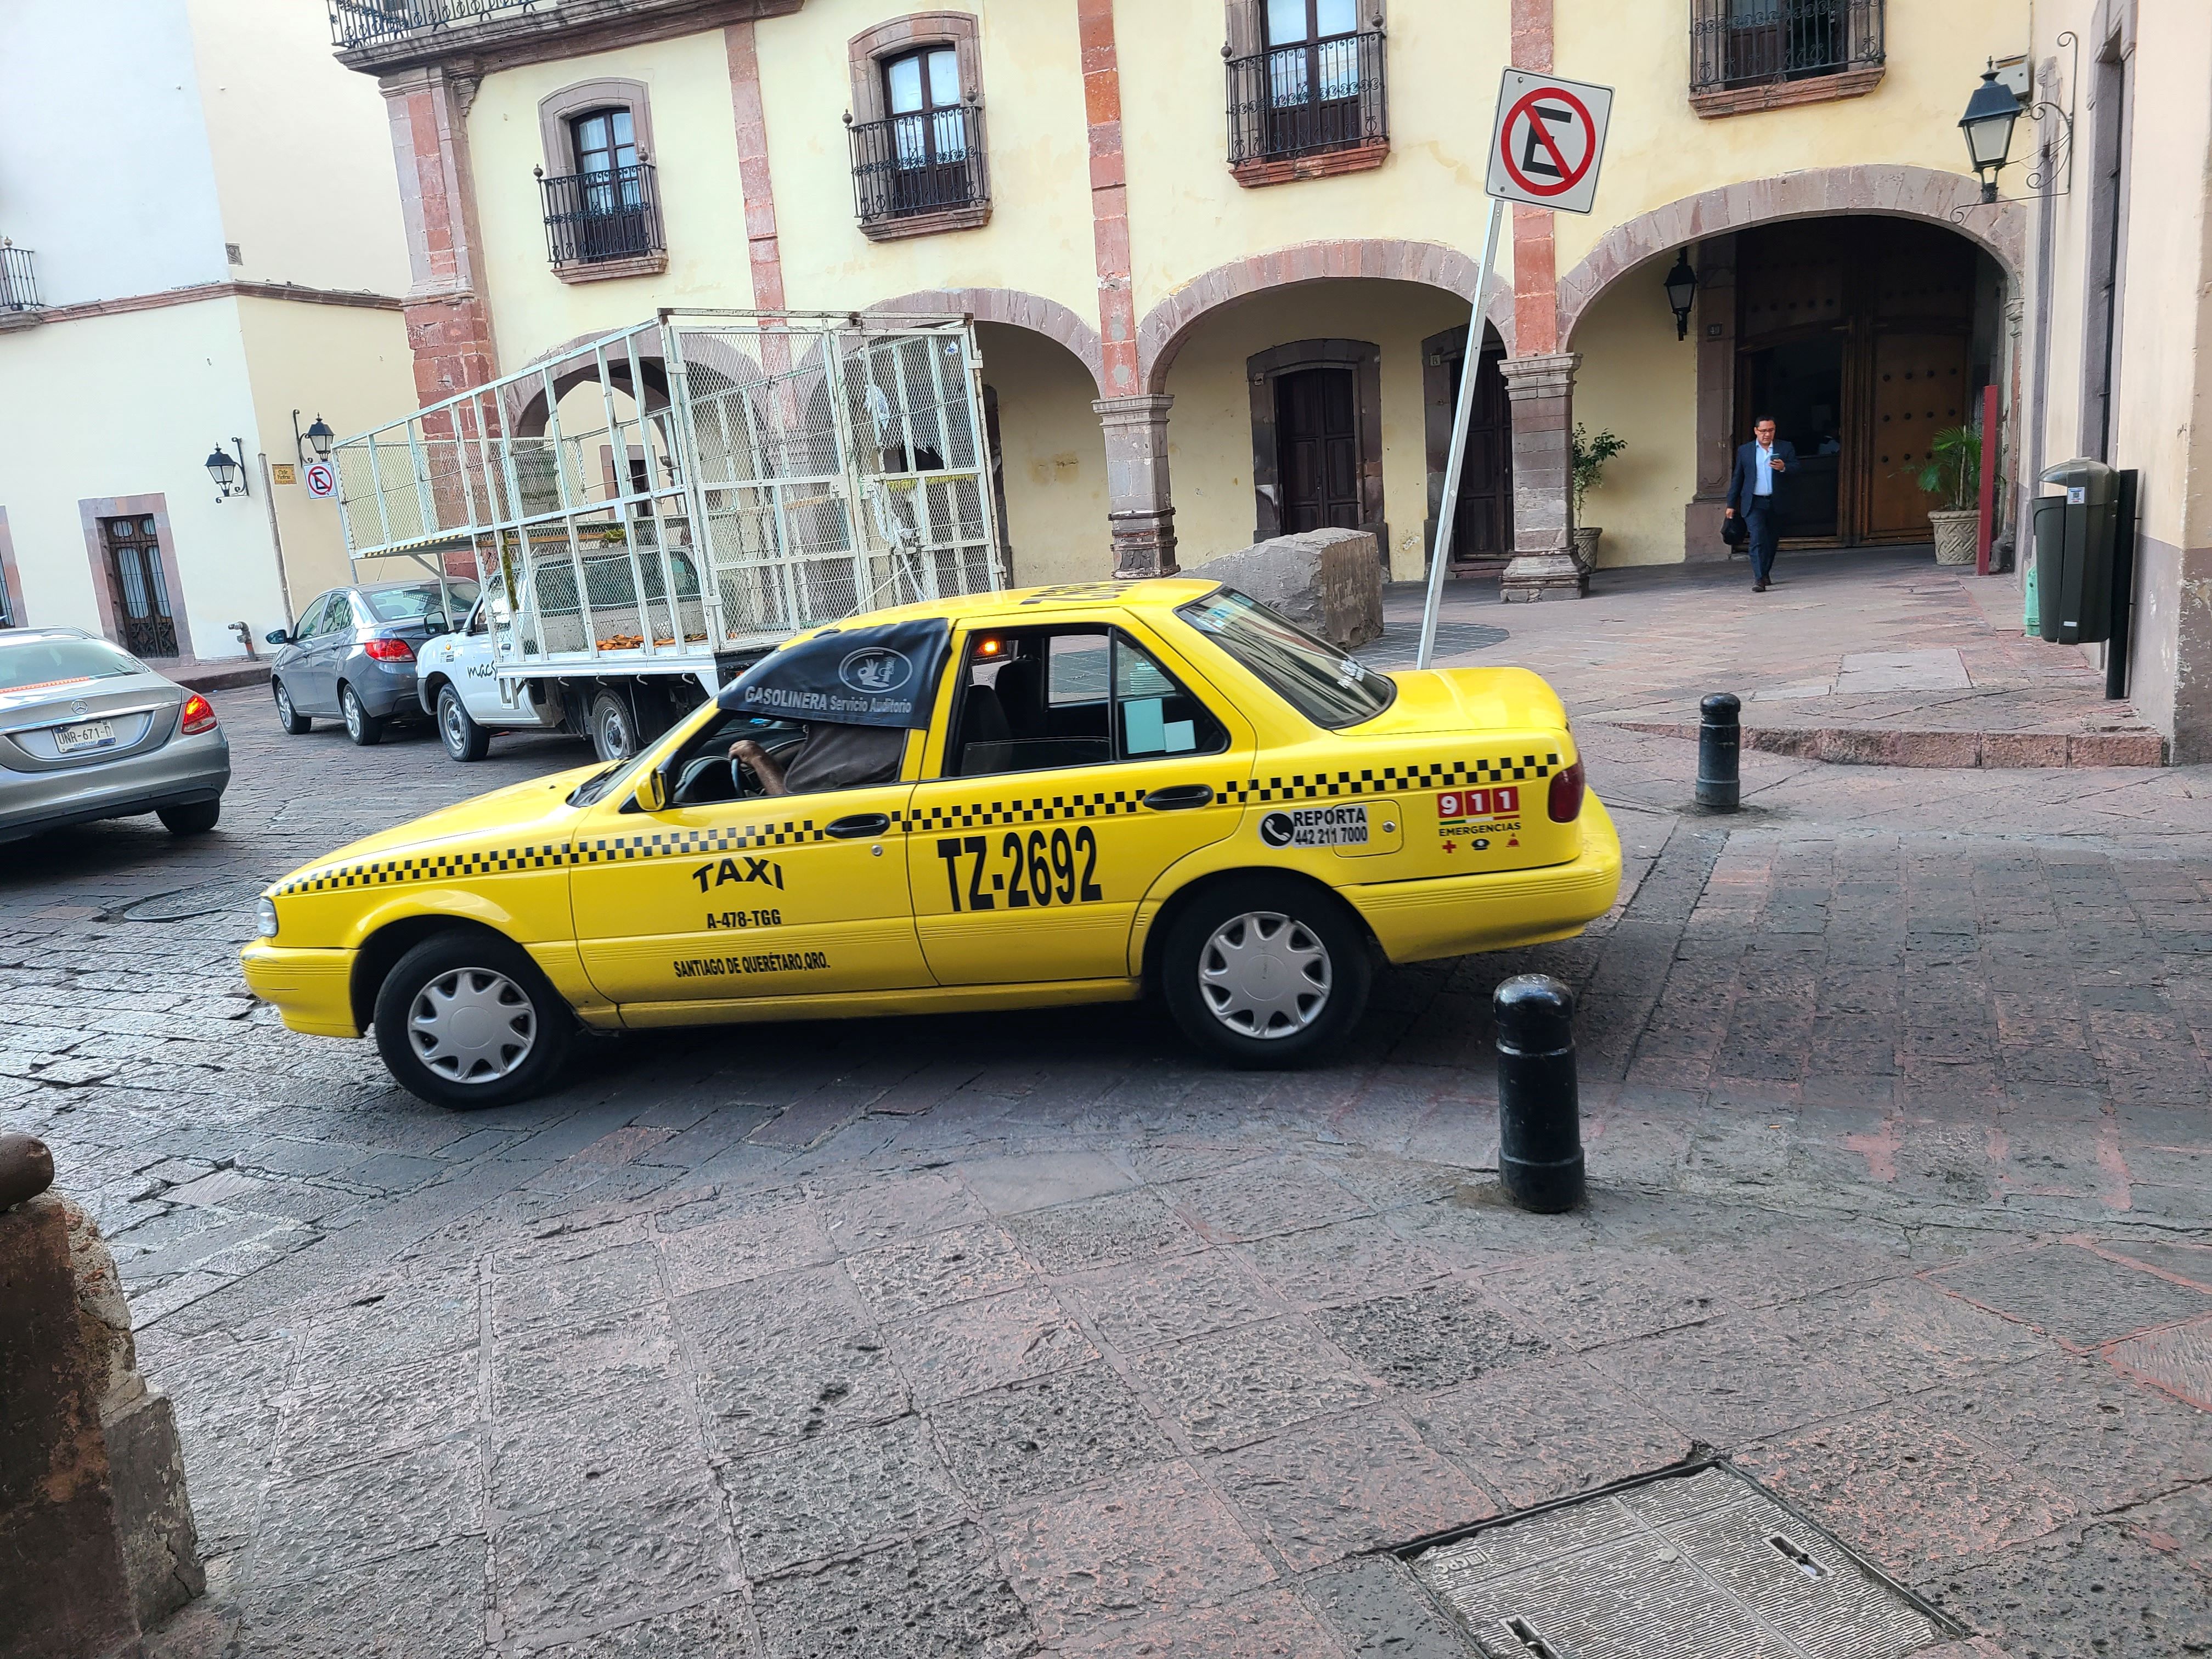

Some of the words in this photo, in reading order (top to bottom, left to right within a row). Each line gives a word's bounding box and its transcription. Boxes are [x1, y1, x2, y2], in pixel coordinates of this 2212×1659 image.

[744, 686, 827, 710] GASOLINERA
[830, 695, 868, 712] Servicio
[868, 697, 912, 713] Auditorio
[57, 725, 112, 745] UNR-671-D
[1441, 791, 1510, 814] 911
[1293, 808, 1367, 827] REPORTA
[1295, 829, 1315, 845] 442
[1318, 827, 1338, 844] 211
[1340, 825, 1368, 843] 7000
[1438, 822, 1521, 837] EMERGENCIAS
[692, 856, 785, 894] TAXI
[936, 825, 1103, 912] TZ-2692
[707, 909, 782, 929] A-478-TGG
[673, 958, 725, 978] SANTIAGO
[725, 957, 741, 975] DE
